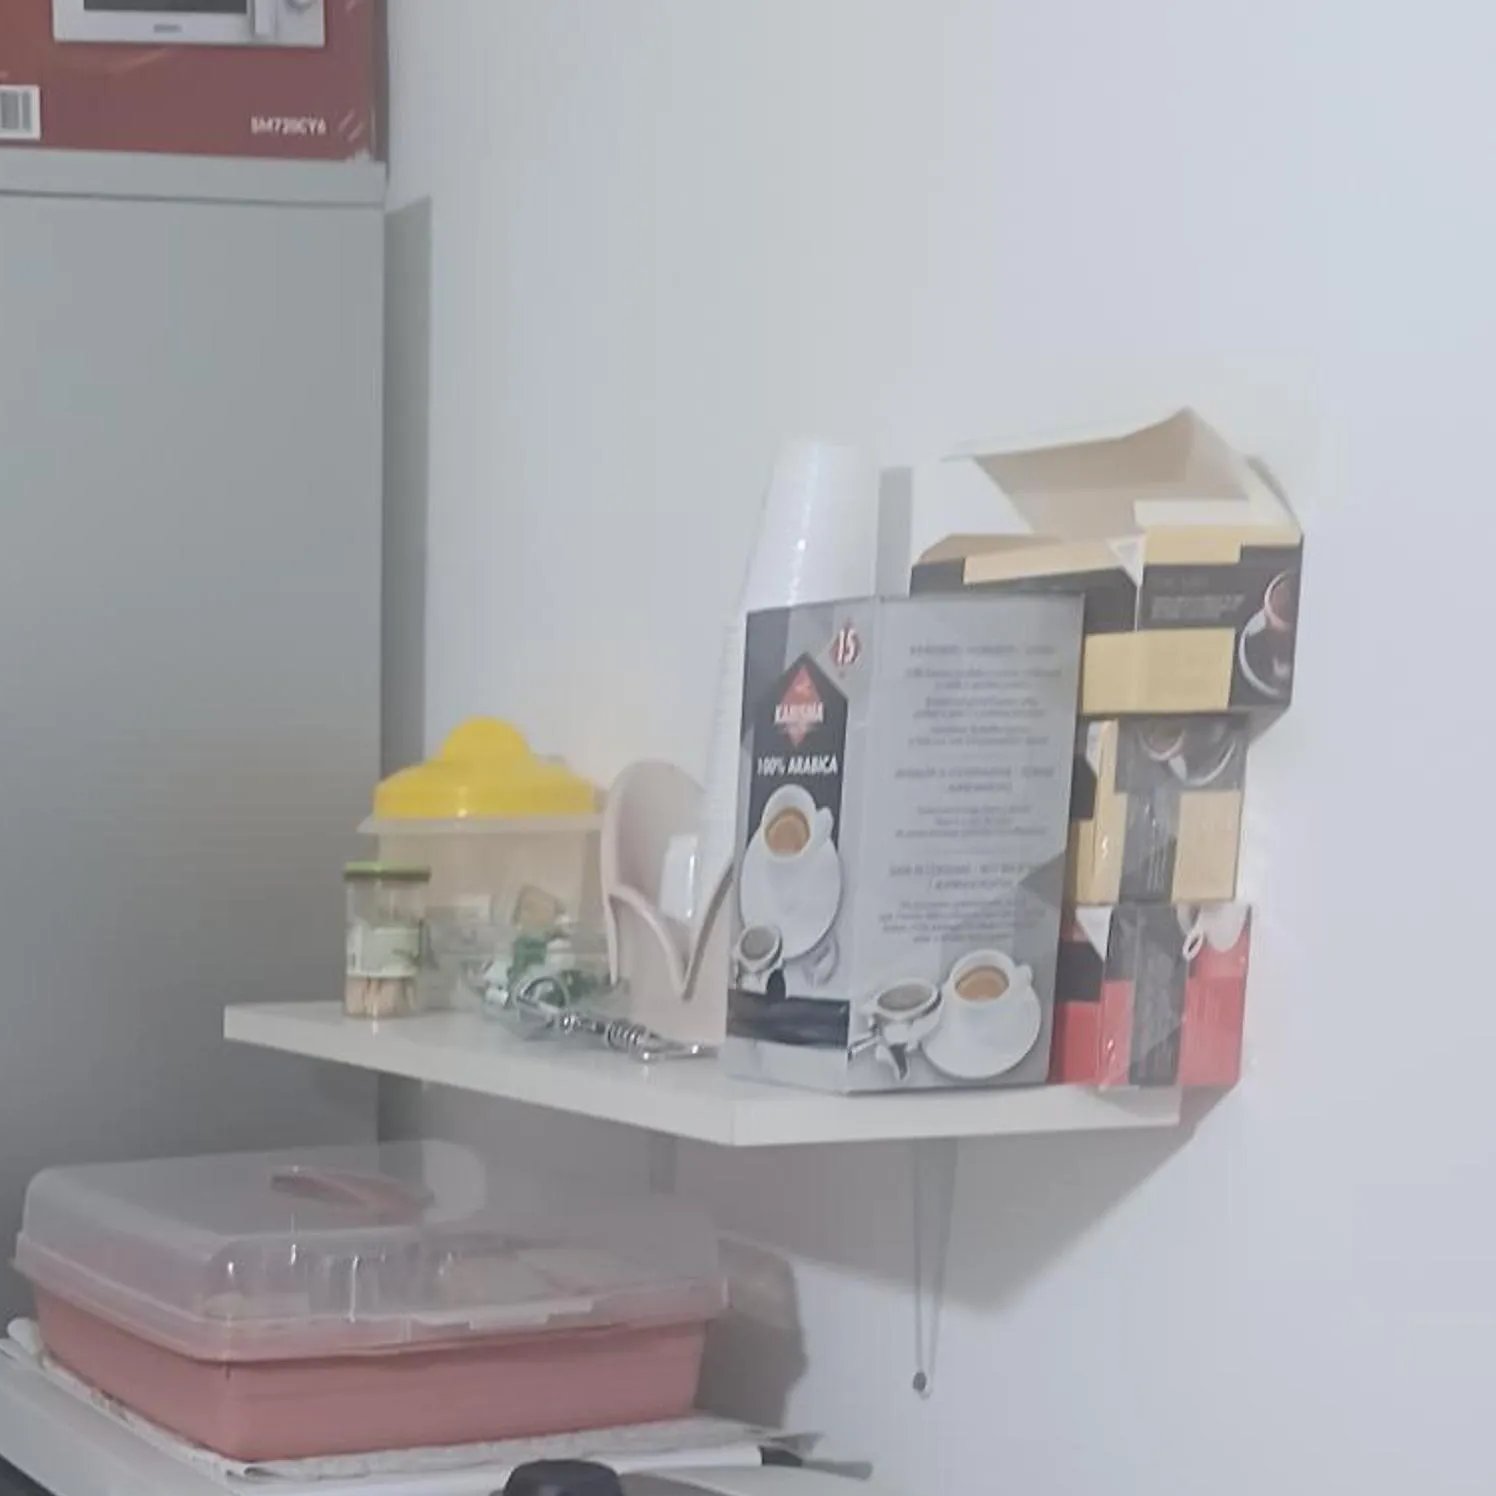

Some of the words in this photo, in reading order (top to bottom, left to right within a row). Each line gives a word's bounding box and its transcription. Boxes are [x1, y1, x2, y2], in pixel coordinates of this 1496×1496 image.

[837, 627, 856, 665] 15
[756, 755, 786, 777] 100%
[787, 753, 838, 775] ARABICA
